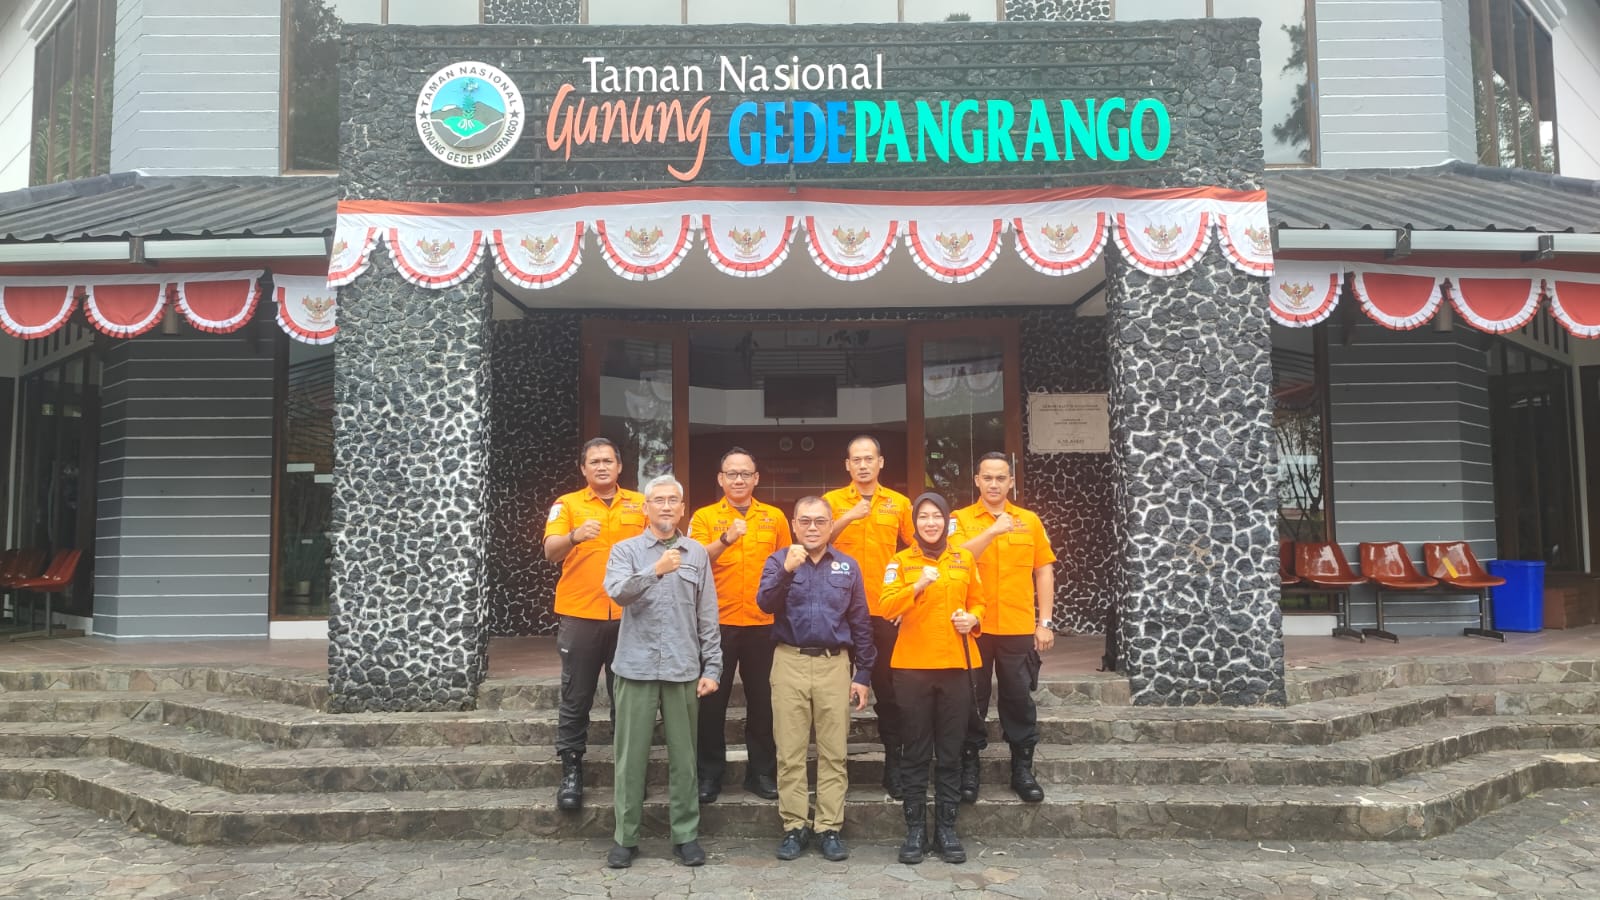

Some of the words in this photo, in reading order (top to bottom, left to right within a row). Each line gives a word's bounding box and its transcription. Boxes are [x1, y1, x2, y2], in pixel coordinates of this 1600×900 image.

[421, 70, 455, 107] TAMAN
[459, 65, 517, 107] NASIONAL
[582, 56, 703, 93] Taman
[719, 54, 884, 93] Nasional
[421, 121, 446, 155] GUNUNG
[446, 151, 474, 165] GEDE
[476, 119, 519, 163] PANGRANGO
[546, 83, 711, 181] Gunung
